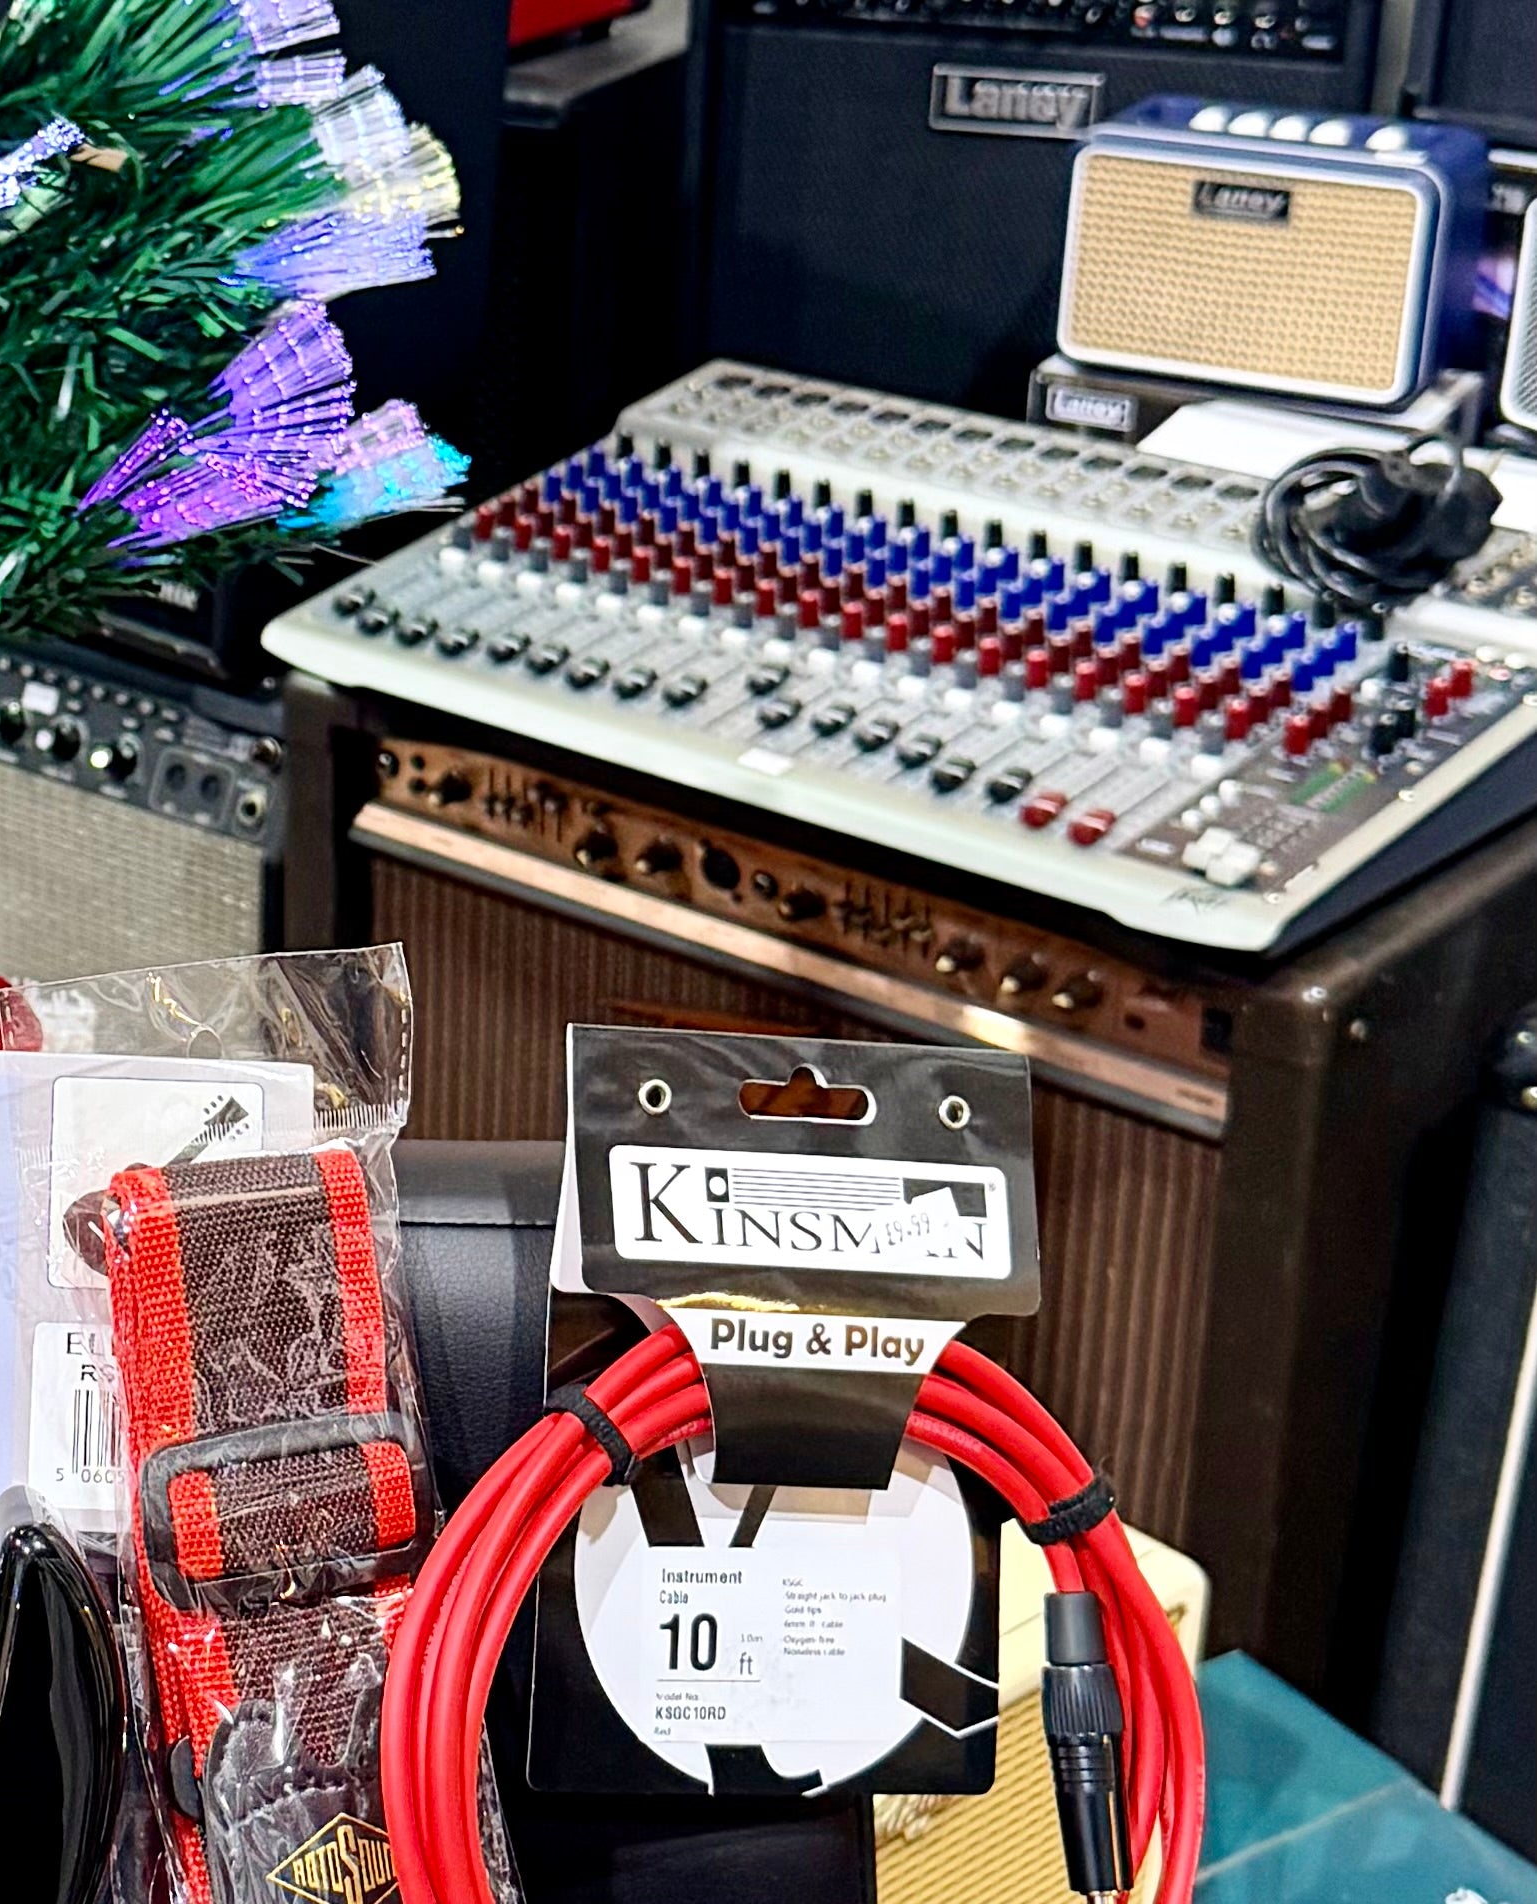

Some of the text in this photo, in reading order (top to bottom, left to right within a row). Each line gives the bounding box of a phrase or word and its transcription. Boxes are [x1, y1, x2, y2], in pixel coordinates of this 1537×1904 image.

[945, 72, 1088, 131] Laney
[629, 1160, 987, 1261] KINSMN
[710, 1317, 926, 1367] Plug & Play
[659, 1589, 689, 1604] Cable
[661, 1568, 743, 1585] Instrument
[659, 1612, 718, 1671] 10
[739, 1651, 754, 1676] ft
